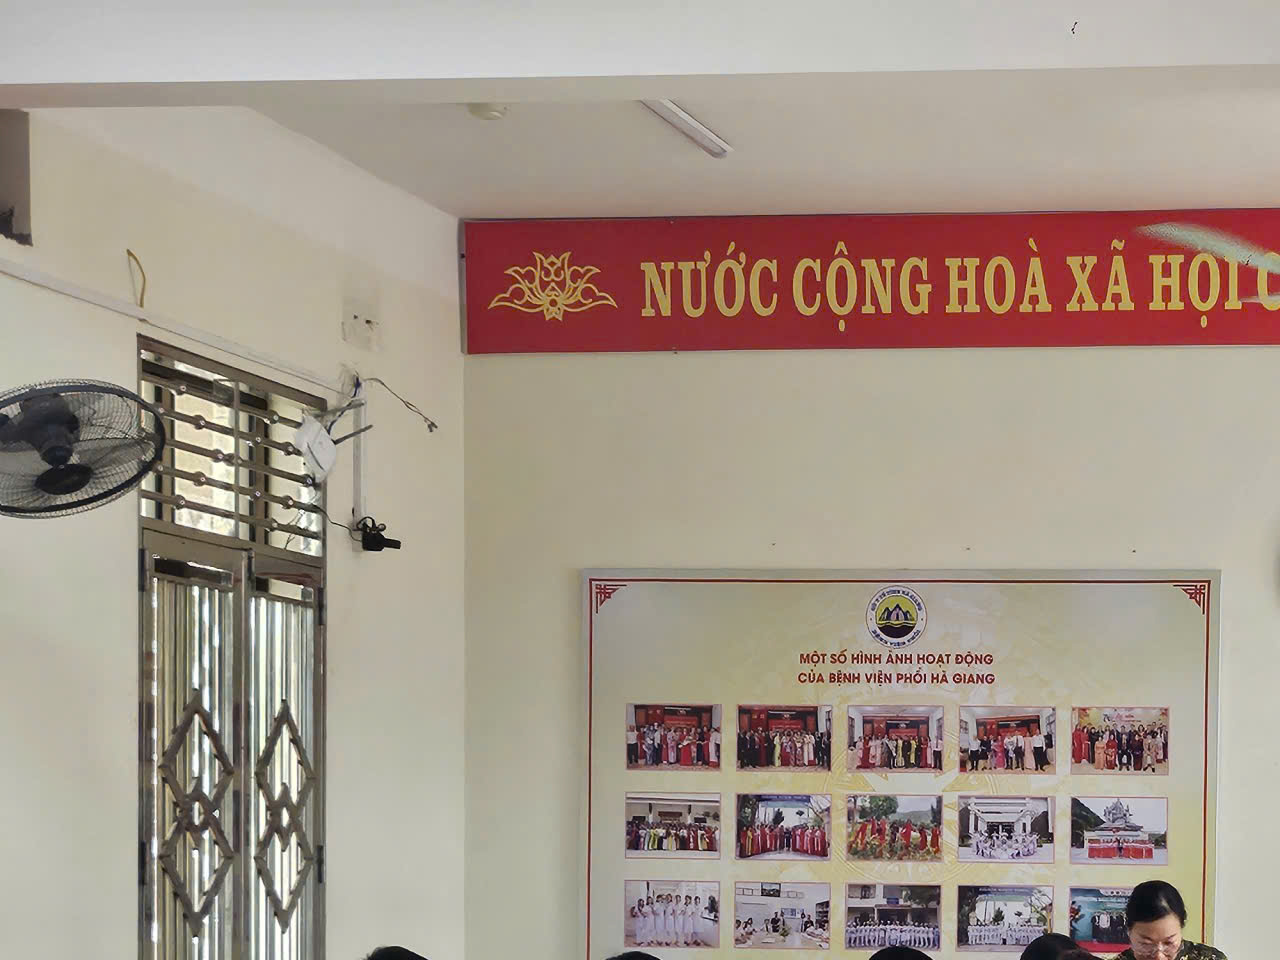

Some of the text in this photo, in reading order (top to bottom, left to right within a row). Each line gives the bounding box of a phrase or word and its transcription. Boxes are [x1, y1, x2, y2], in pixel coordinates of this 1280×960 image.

[641, 241, 778, 317] NƯỚC
[792, 240, 932, 332] CỘNG
[945, 237, 1052, 314] HOÀ
[1066, 239, 1135, 312] XÃ
[800, 650, 827, 667] MỘT
[830, 648, 847, 664] SỐ
[851, 650, 882, 664] HÌNH
[916, 653, 951, 668] HOẠT
[955, 651, 994, 667] ĐỘNG
[797, 667, 996, 687] CỦA BỆNH VIỆN PHỔI HÀ GIANG
